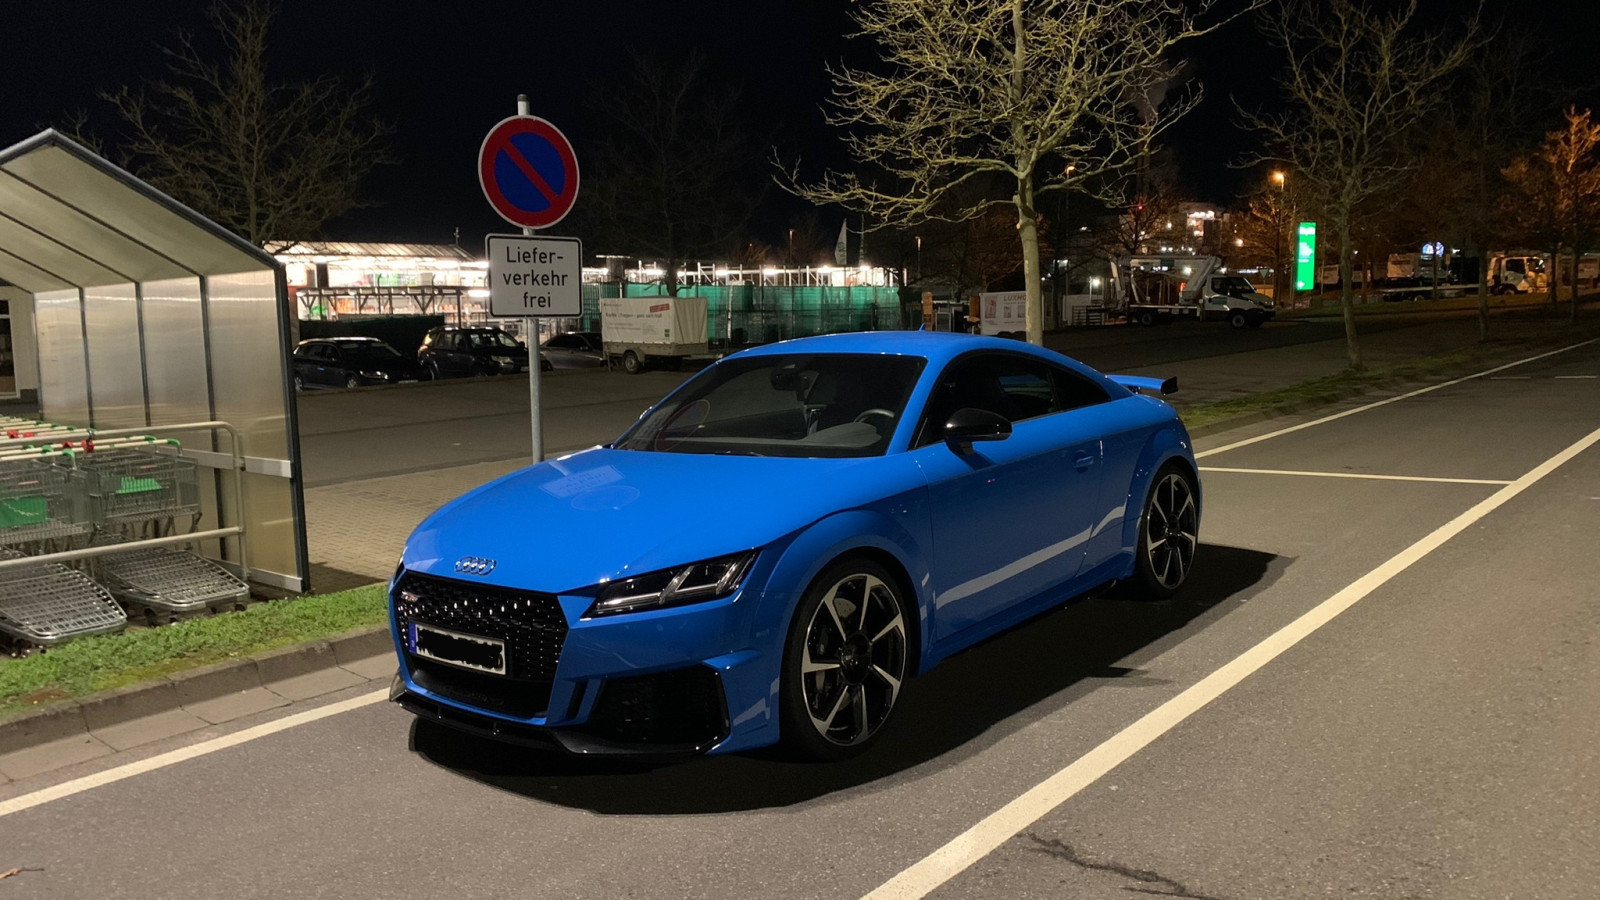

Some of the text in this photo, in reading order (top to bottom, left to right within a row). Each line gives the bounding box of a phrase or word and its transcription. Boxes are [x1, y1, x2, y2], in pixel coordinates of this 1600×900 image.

[506, 245, 564, 264] Liefer-
[502, 269, 568, 286] verkehr
[523, 291, 551, 308] frei
